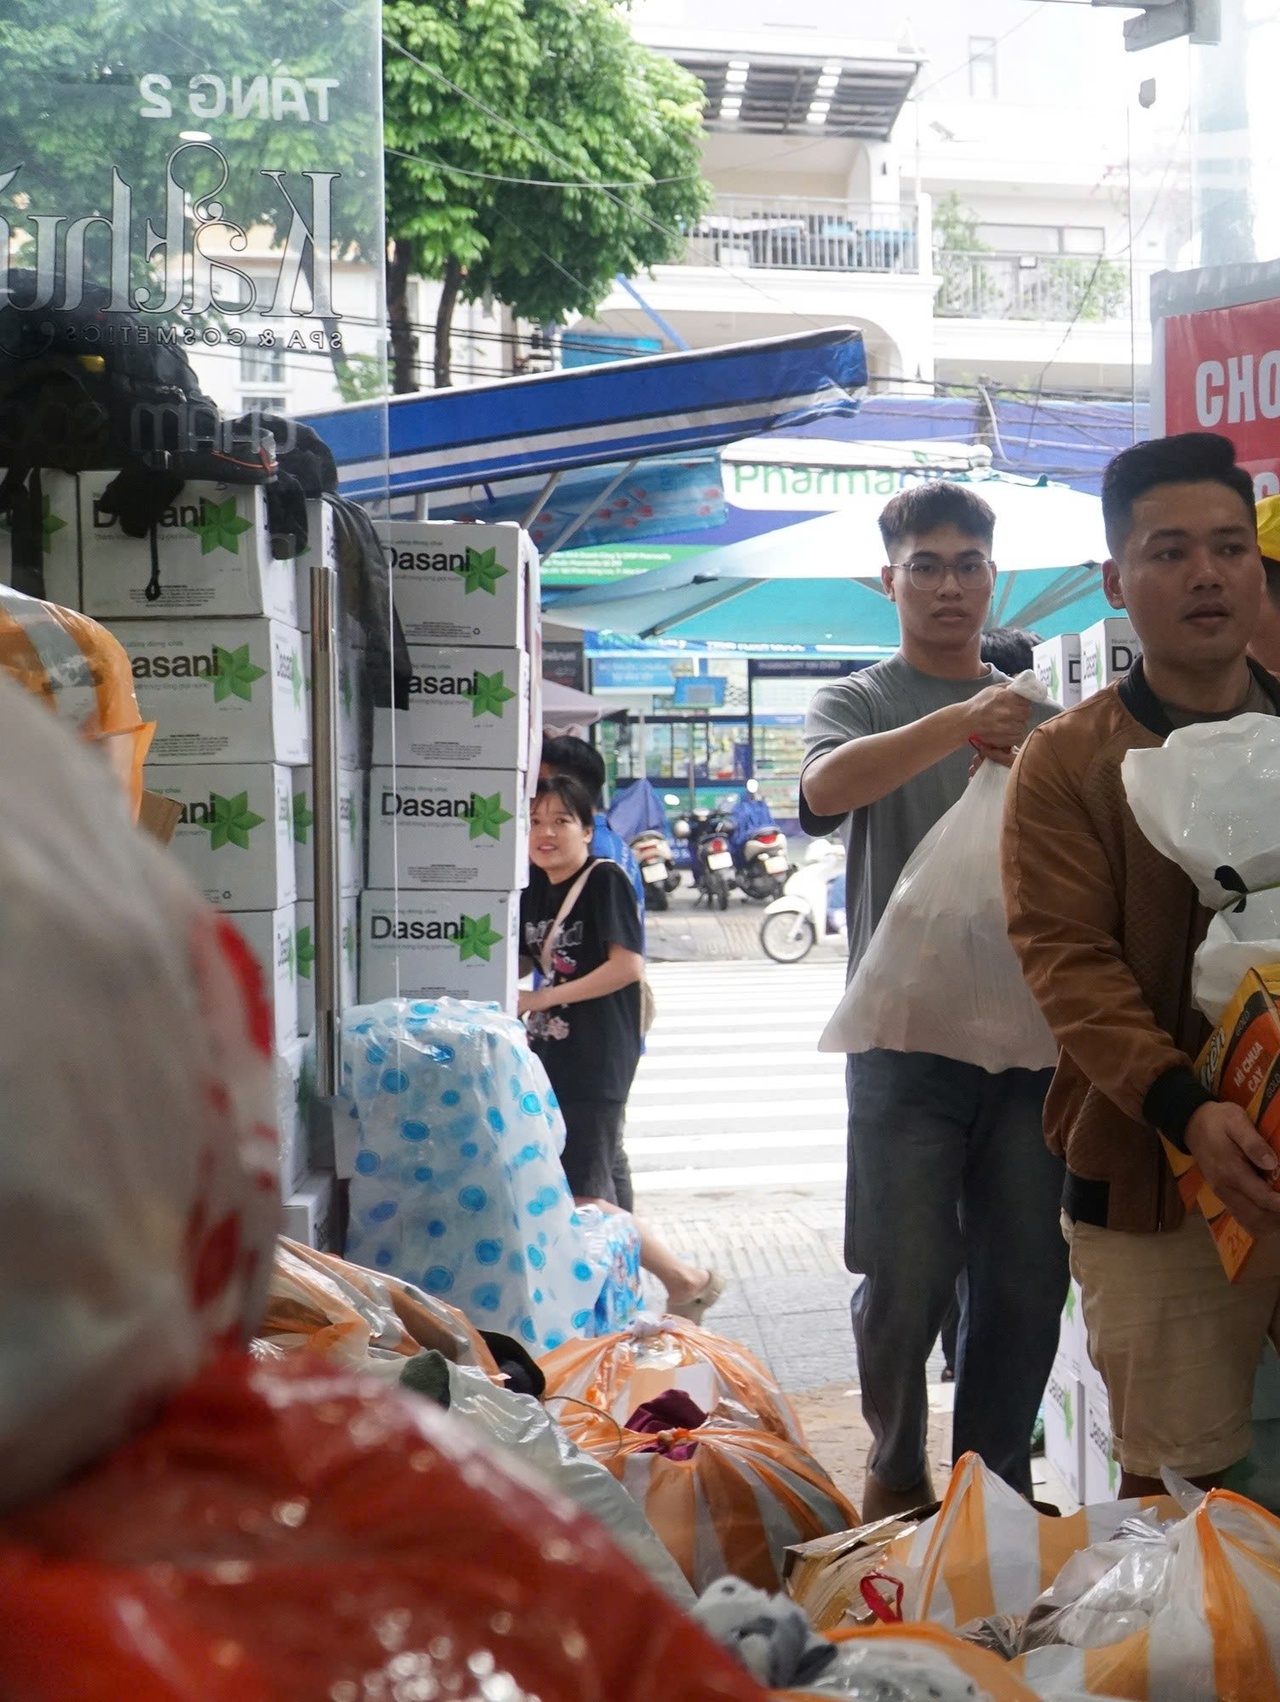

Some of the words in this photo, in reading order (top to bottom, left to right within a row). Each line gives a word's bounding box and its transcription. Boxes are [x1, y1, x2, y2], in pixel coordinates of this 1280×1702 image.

[92, 498, 206, 529] Dani
[132, 644, 219, 679] asani
[408, 669, 479, 696] asani
[177, 792, 217, 825] ani
[381, 792, 476, 818] Dasani
[371, 913, 466, 940] Dasani
